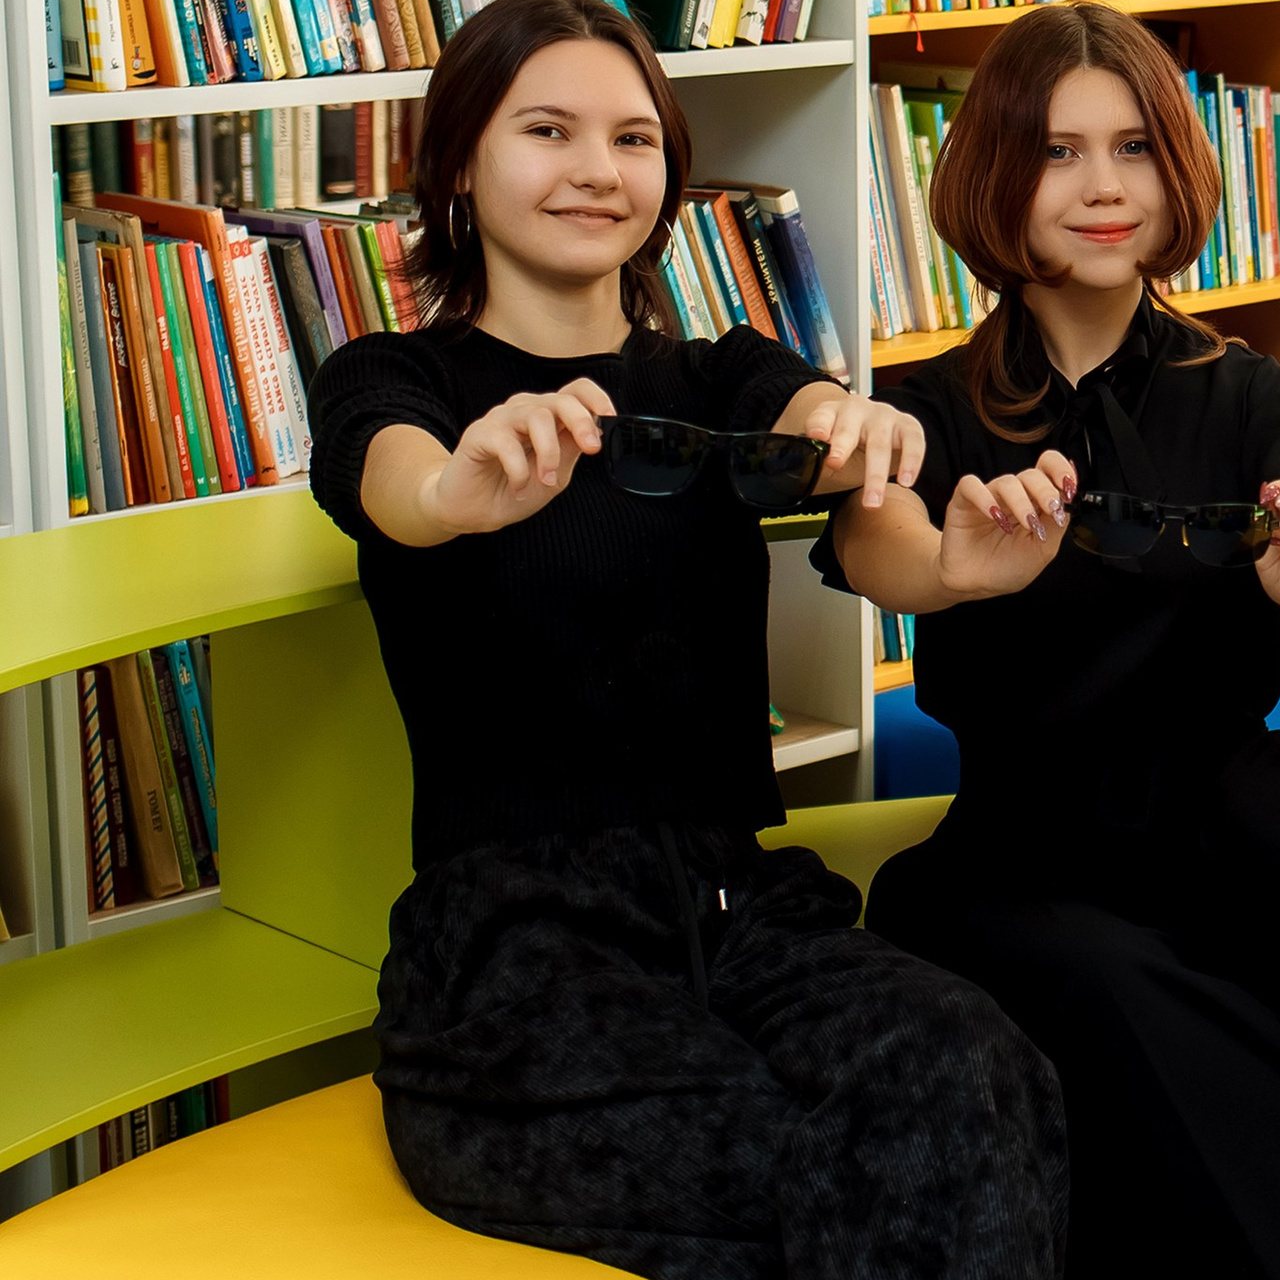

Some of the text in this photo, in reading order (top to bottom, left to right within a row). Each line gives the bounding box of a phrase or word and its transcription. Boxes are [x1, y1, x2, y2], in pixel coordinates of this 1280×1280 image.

[260, 251, 278, 284] Алисы
[753, 239, 779, 305] ХРАНИТЕЛИ
[147, 790, 163, 832] ГОМЕР
